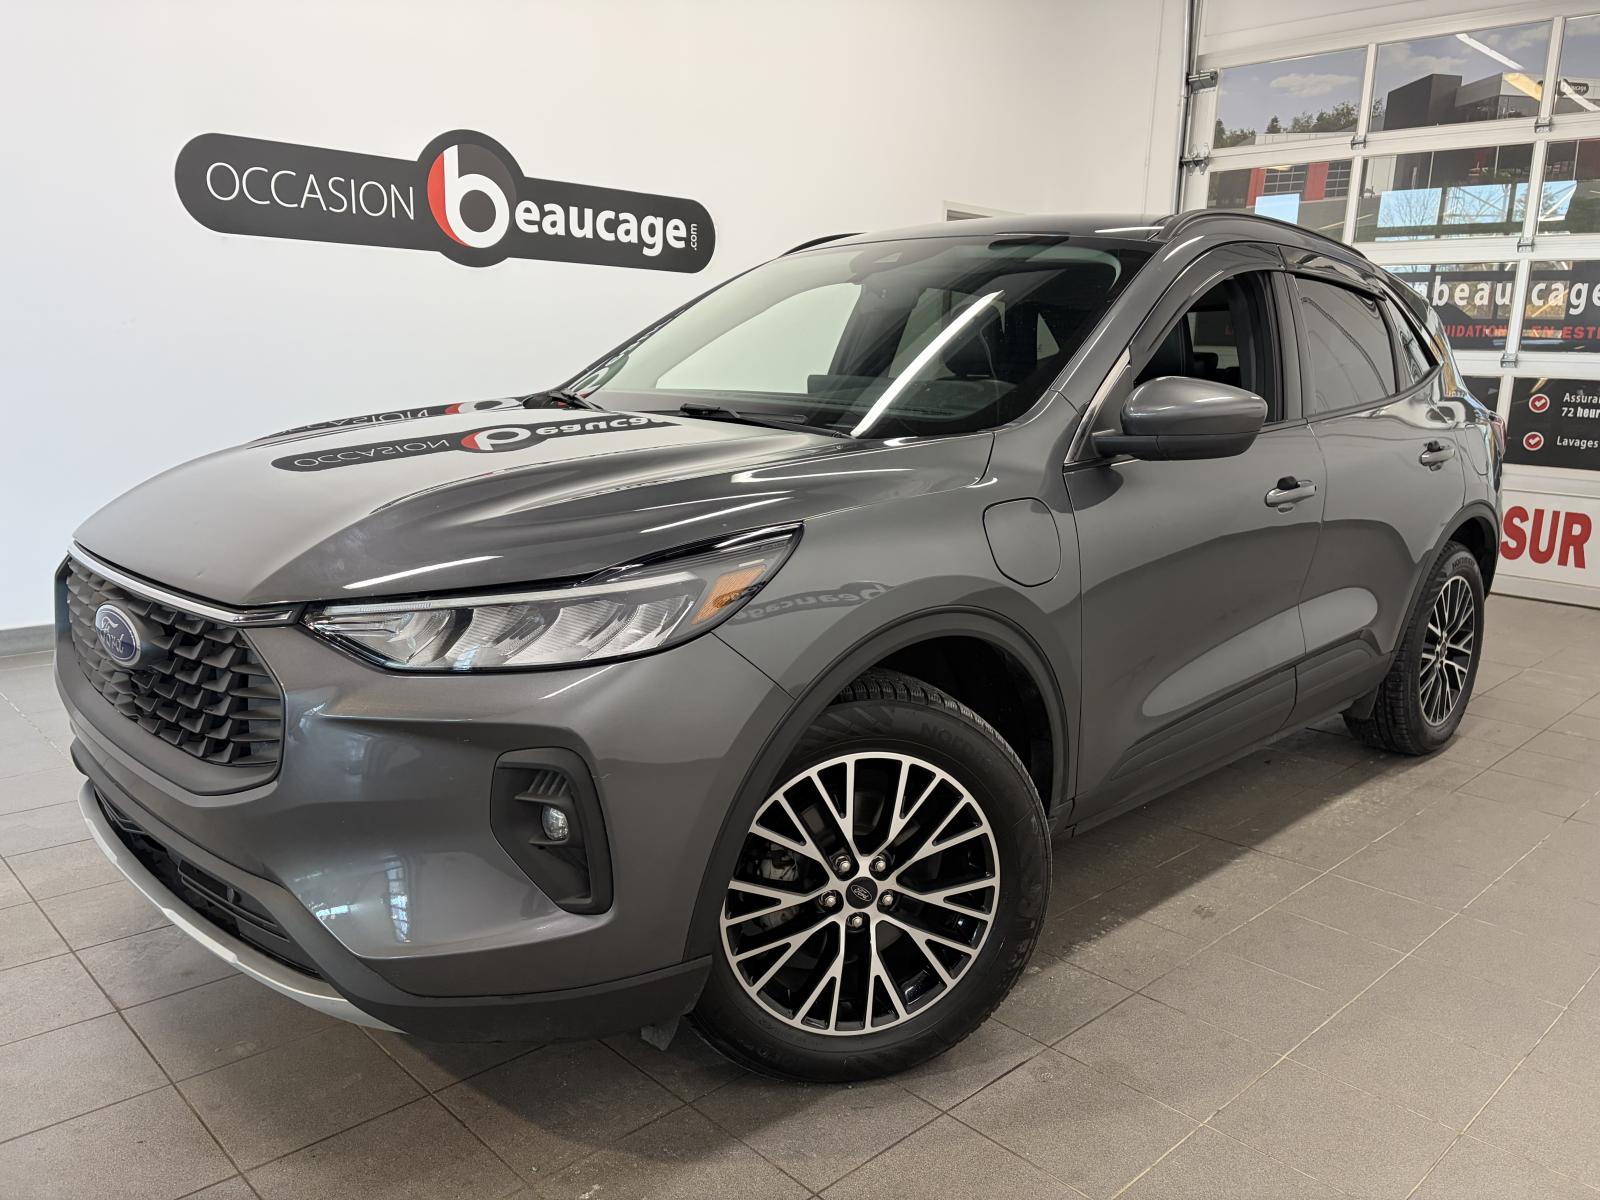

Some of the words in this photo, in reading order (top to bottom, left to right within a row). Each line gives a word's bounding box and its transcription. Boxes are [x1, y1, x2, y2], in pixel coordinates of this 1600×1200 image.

[206, 162, 415, 221] OCCASION
[690, 223, 698, 251] .com
[1561, 326, 1600, 340] EST
[1563, 392, 1600, 404] Assura
[1561, 407, 1574, 417] 72
[1556, 435, 1599, 450] Lavages
[1500, 505, 1593, 569] SUR
[99, 616, 124, 654] Ford
